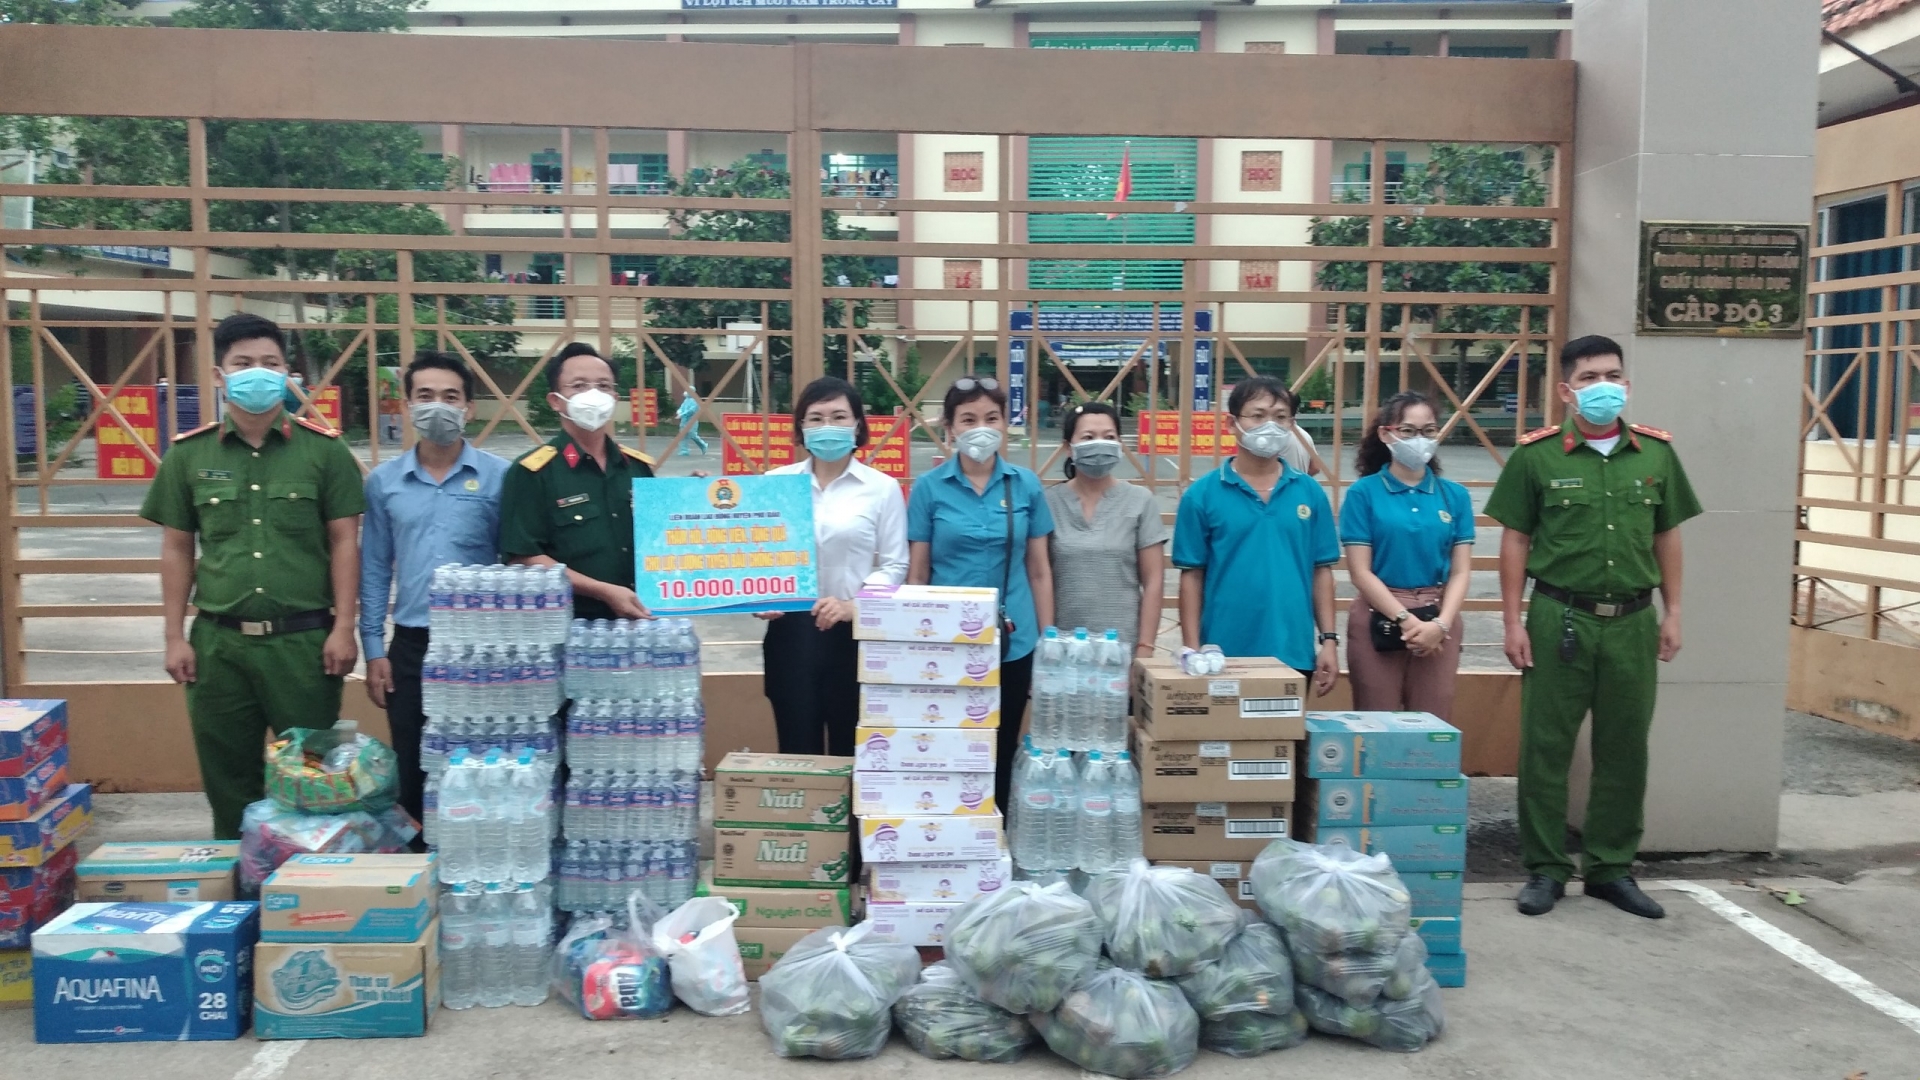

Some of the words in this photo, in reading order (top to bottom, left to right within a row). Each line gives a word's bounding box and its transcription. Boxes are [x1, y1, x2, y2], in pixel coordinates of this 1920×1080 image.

[1768, 304, 1784, 324] 3
[659, 576, 796, 598] 10.000.000đ
[758, 788, 805, 809] Nuti
[756, 840, 808, 863] Nuti
[756, 906, 802, 919] Nguyên
[804, 904, 832, 918] Chất
[53, 976, 166, 1005] AQUAFINA
[198, 992, 228, 1009] 28
[199, 1012, 228, 1020] CHAI
